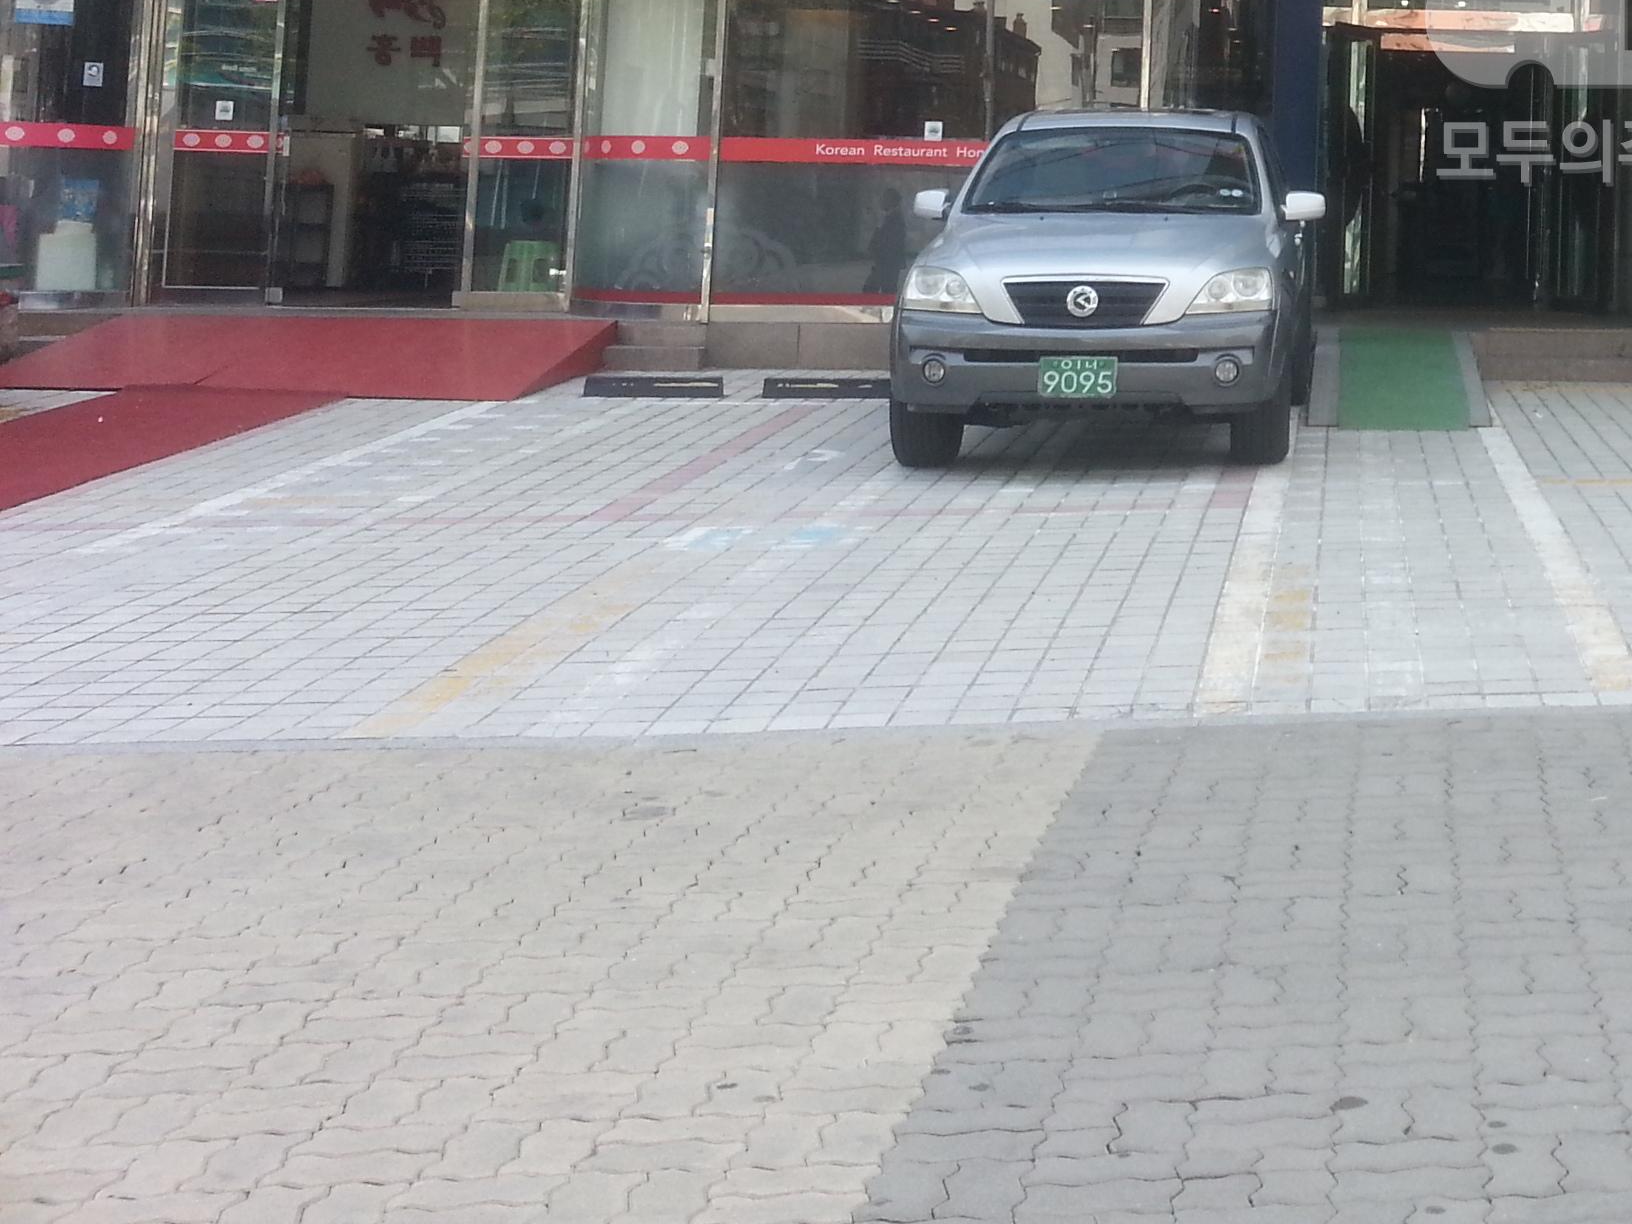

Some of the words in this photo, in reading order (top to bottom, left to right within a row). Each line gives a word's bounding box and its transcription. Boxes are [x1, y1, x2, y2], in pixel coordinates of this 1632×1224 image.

[815, 144, 865, 156] Korean
[873, 144, 947, 158] Restaurant
[1043, 370, 1113, 393] 9095
